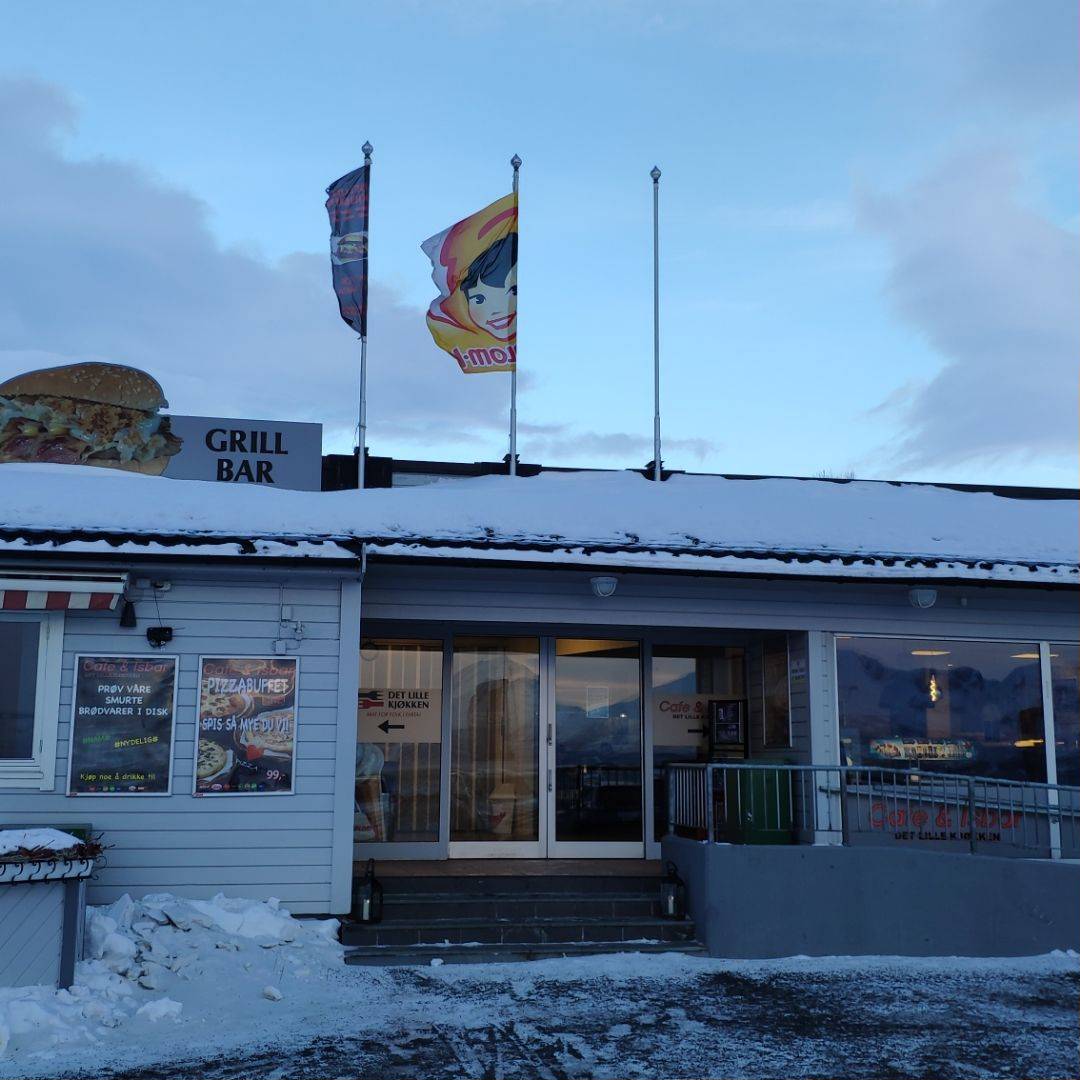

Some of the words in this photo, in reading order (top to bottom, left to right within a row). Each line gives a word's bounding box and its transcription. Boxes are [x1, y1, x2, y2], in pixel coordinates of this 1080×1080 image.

[205, 428, 289, 455] GRILL
[216, 458, 275, 484] BAR
[98, 684, 124, 694] PRØV
[127, 683, 152, 694] VÅRE
[207, 677, 289, 694] PIZZABUFFET
[105, 696, 143, 705] SMURTE
[388, 691, 406, 699] DET
[408, 691, 430, 699] LILLE
[79, 706, 133, 716] BRØDVARER
[137, 706, 142, 716] I
[146, 707, 169, 716] DISK
[388, 701, 429, 709] KJØKKEN
[659, 701, 689, 713] Cafe
[202, 718, 223, 731] SPIS
[241, 718, 260, 731] MYE
[266, 769, 286, 781] 99,-
